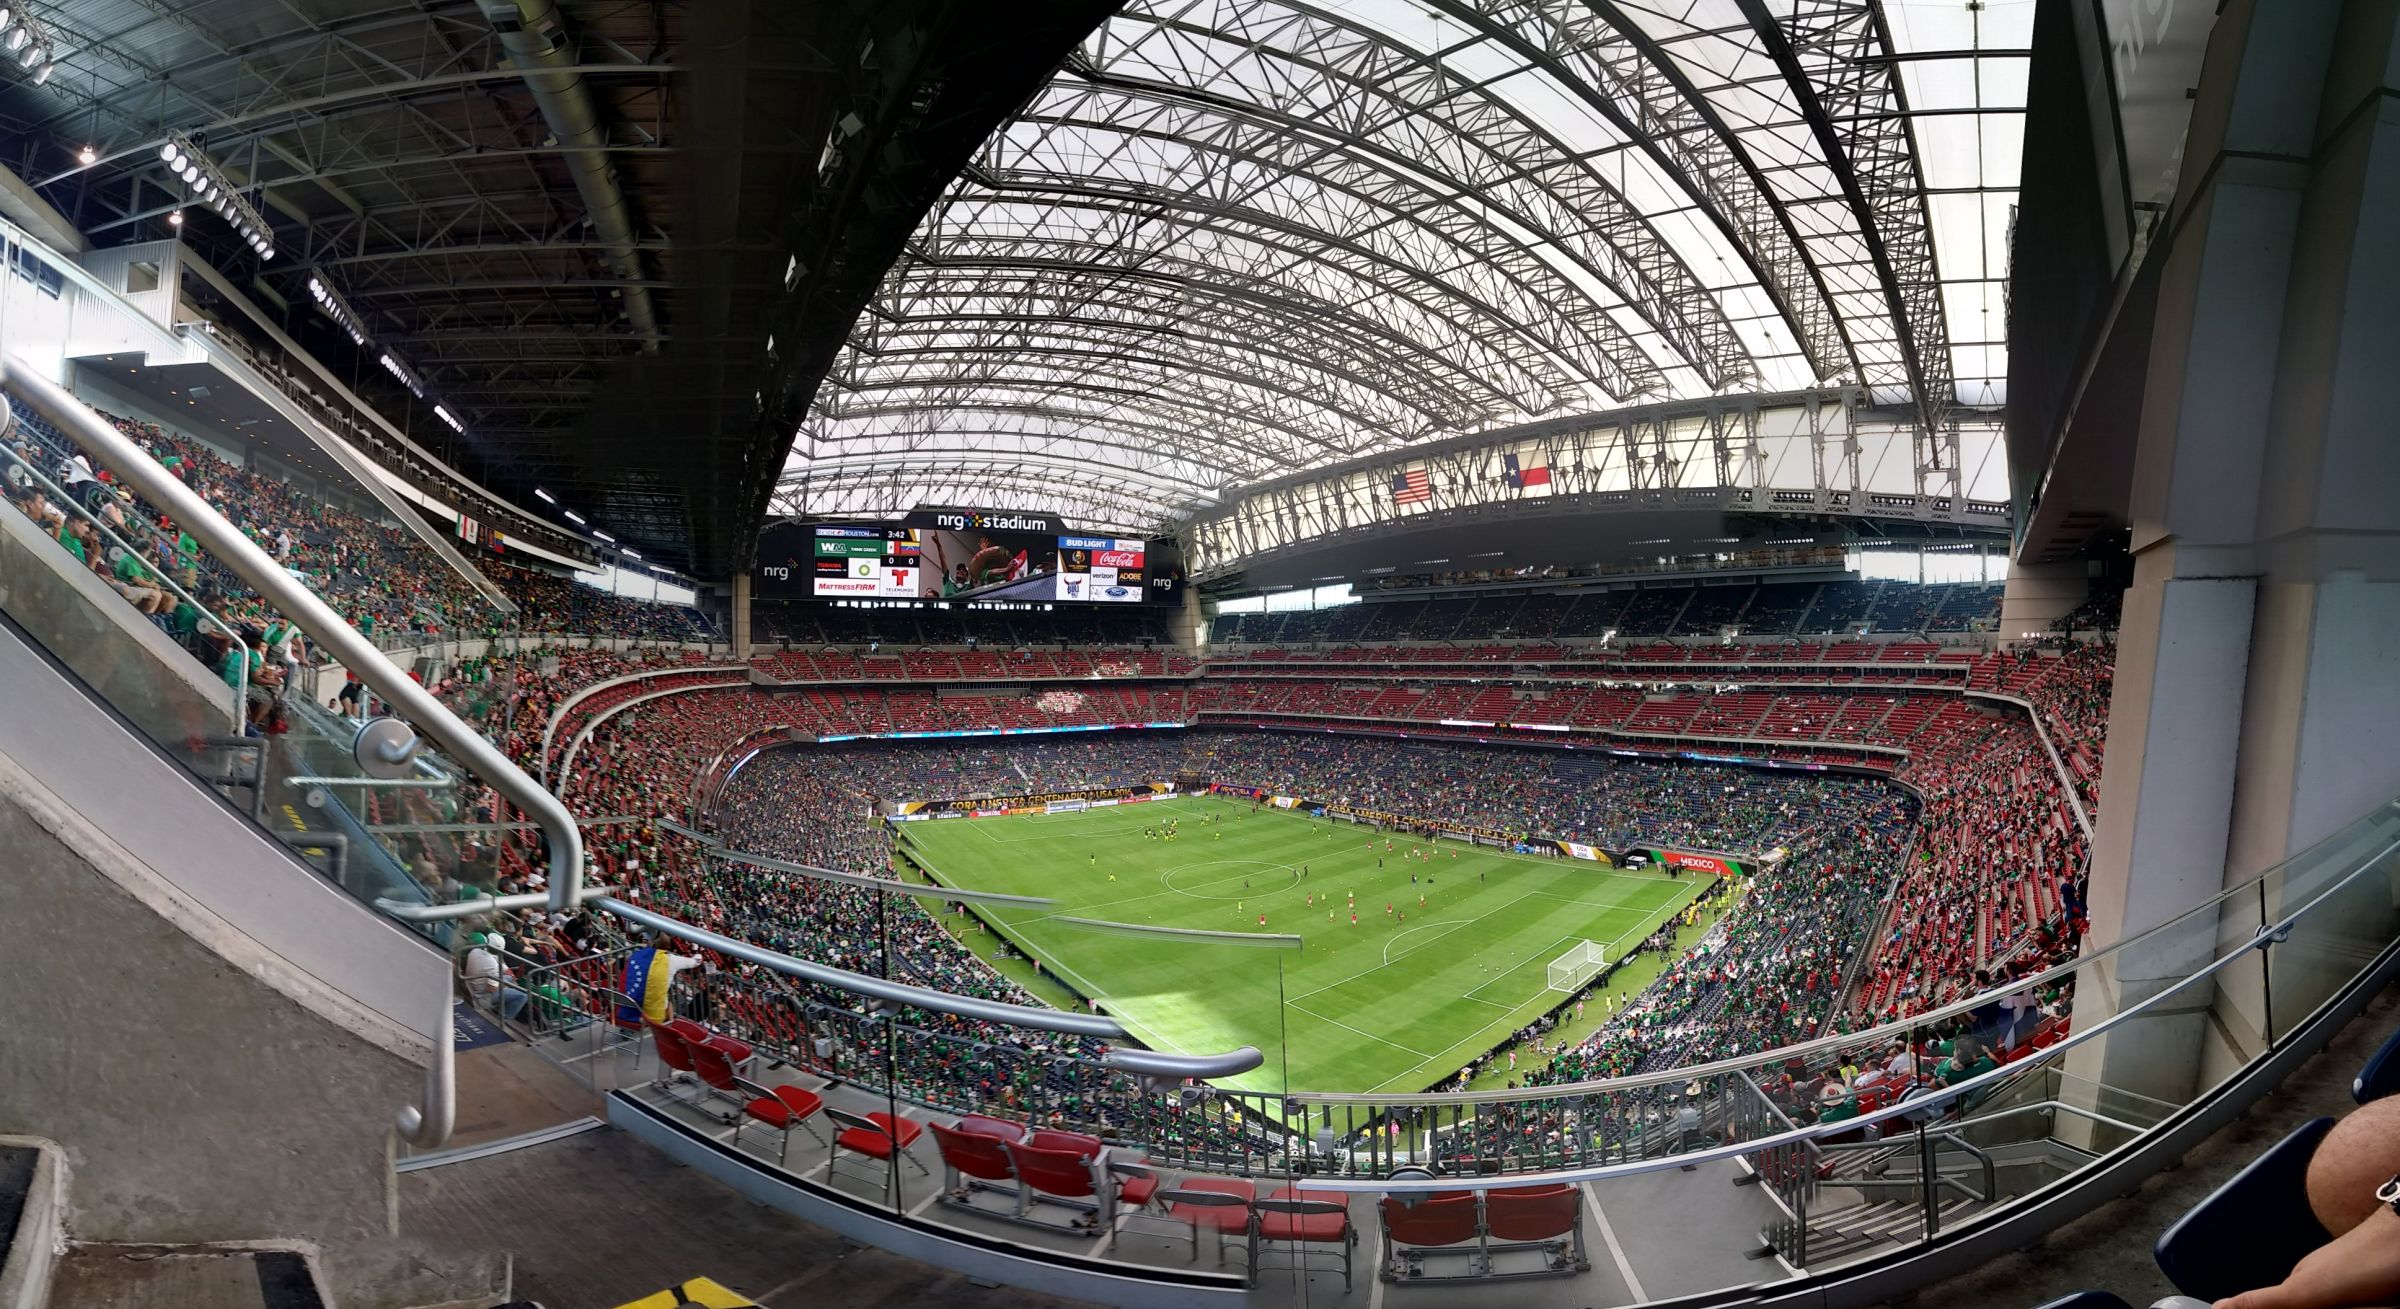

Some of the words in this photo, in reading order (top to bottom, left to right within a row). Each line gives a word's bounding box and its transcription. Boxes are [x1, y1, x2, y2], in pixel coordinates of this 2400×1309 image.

[937, 514, 964, 531] nrg
[982, 515, 1047, 531] stadium
[887, 530, 905, 539] 3:42
[1066, 539, 1083, 547] BUD
[1084, 540, 1106, 548] LIGHT
[1099, 552, 1135, 567] Coca-Cola
[764, 565, 789, 581] nrg
[1119, 573, 1142, 581] ADOBE
[1153, 578, 1172, 590] nrg
[1096, 789, 1114, 798] USA
[1114, 787, 1132, 797] 2016
[1680, 857, 1714, 869] MEXICO
